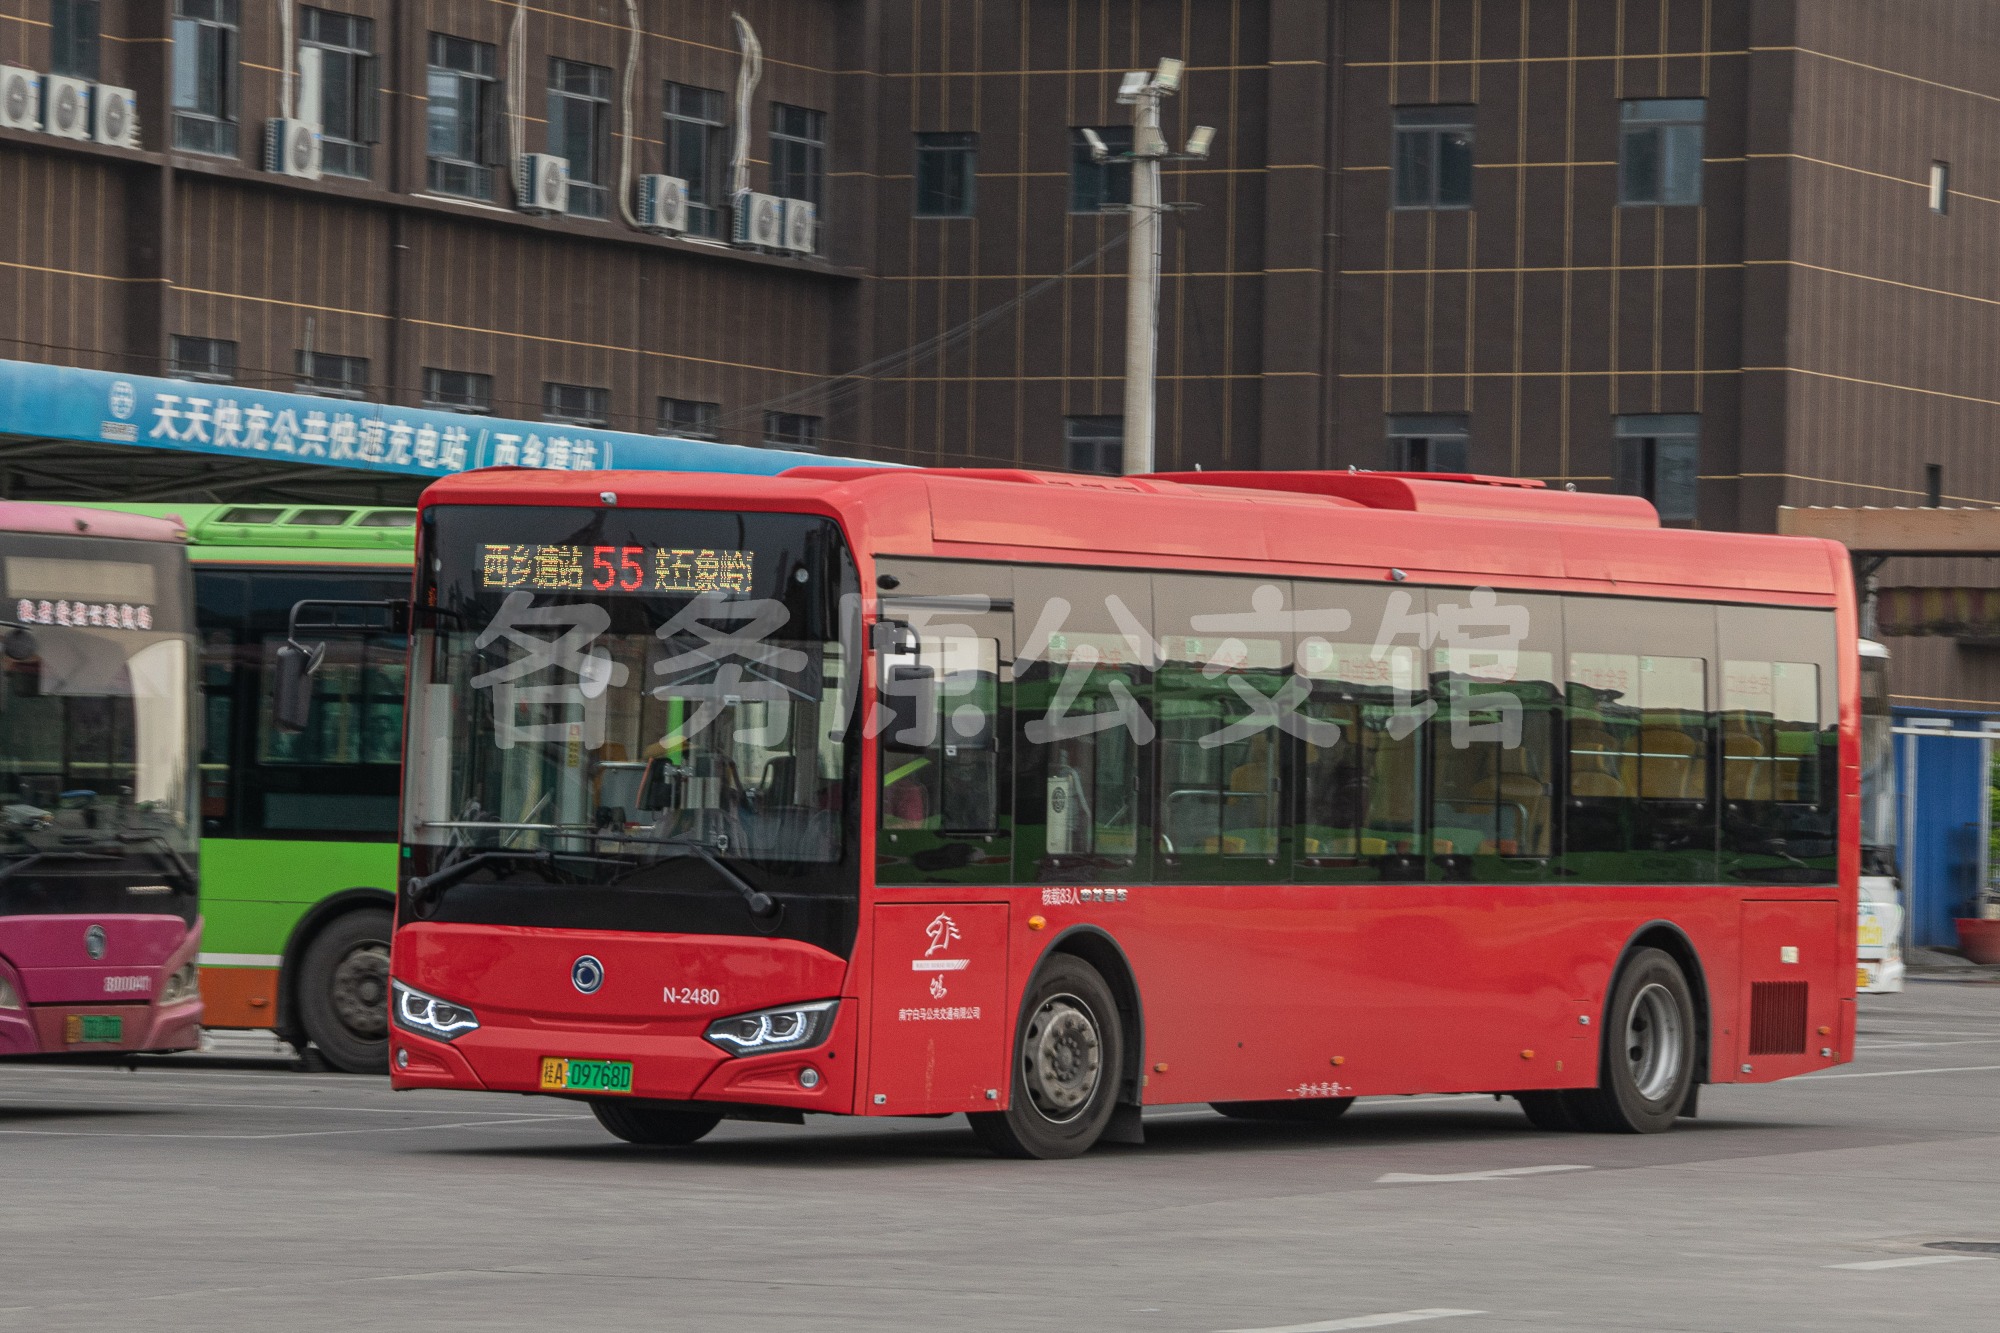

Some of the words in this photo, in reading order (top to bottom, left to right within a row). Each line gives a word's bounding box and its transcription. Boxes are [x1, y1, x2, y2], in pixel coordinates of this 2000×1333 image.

[483, 544, 584, 589] 西乡塘站
[592, 546, 644, 591] 55
[663, 986, 720, 1006] N-2480
[898, 1006, 981, 1021] 南宁白马公共交通有限公司
